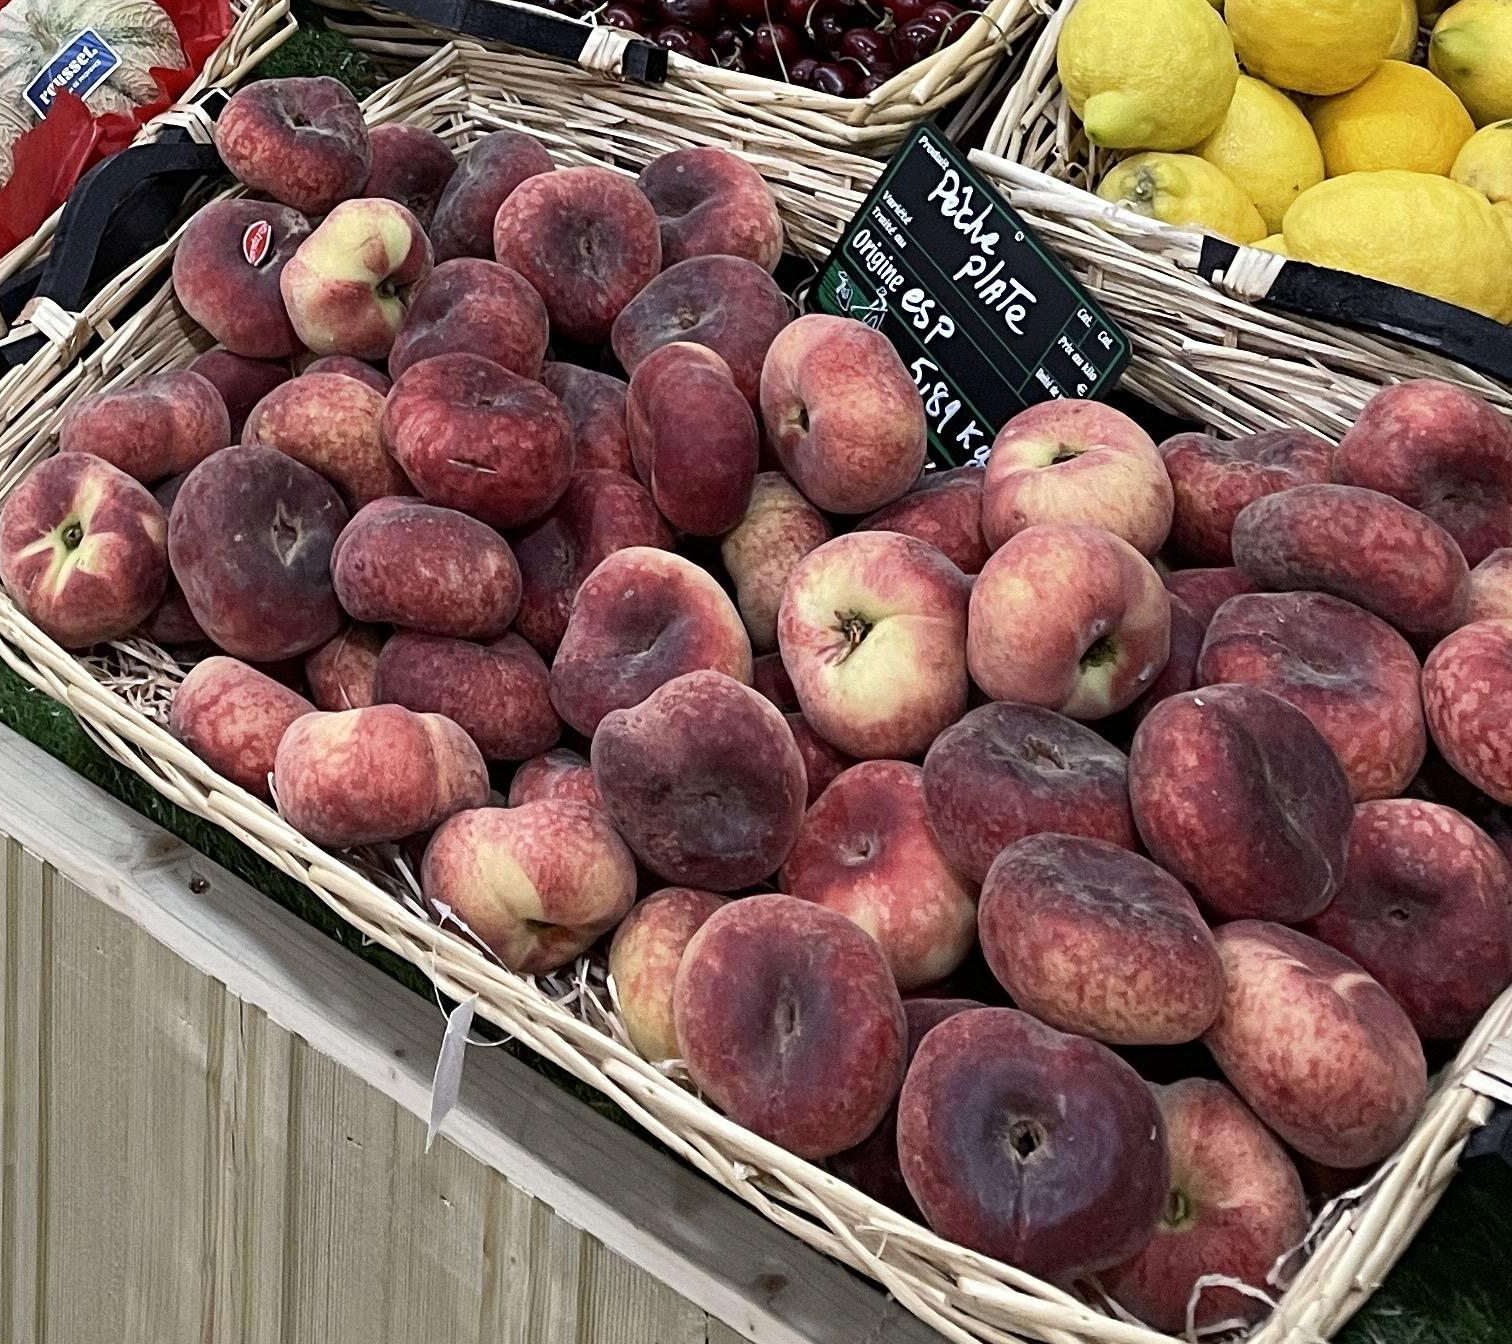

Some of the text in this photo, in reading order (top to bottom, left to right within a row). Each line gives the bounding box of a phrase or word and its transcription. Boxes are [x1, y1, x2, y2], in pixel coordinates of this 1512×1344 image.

[882, 190, 913, 224] Variété
[918, 136, 999, 255] Produit Pêche
[871, 206, 899, 237] Traité
[852, 229, 905, 292] Origine
[1058, 336, 1097, 381] Prix au kilo
